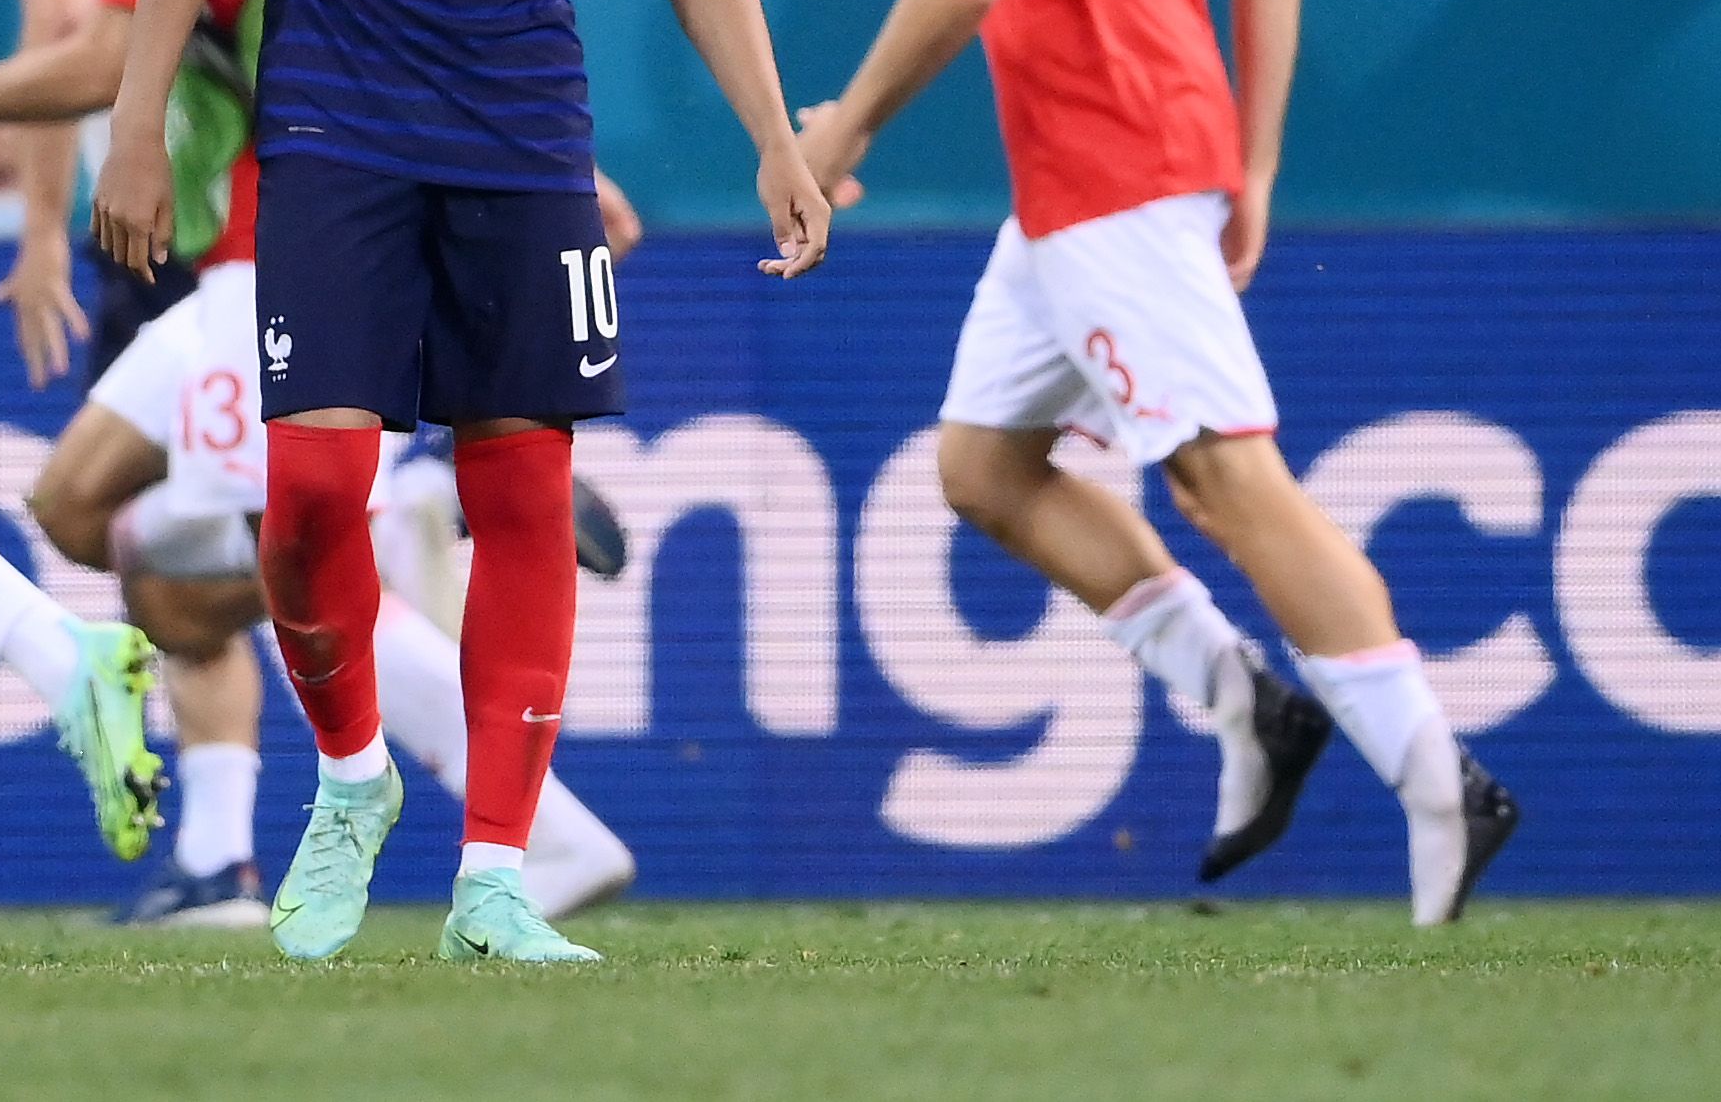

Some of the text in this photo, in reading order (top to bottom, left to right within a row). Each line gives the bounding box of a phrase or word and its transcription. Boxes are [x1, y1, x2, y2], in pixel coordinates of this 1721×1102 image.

[560, 245, 619, 343] 10
[1086, 329, 1134, 405] 3
[181, 369, 246, 453] 13
